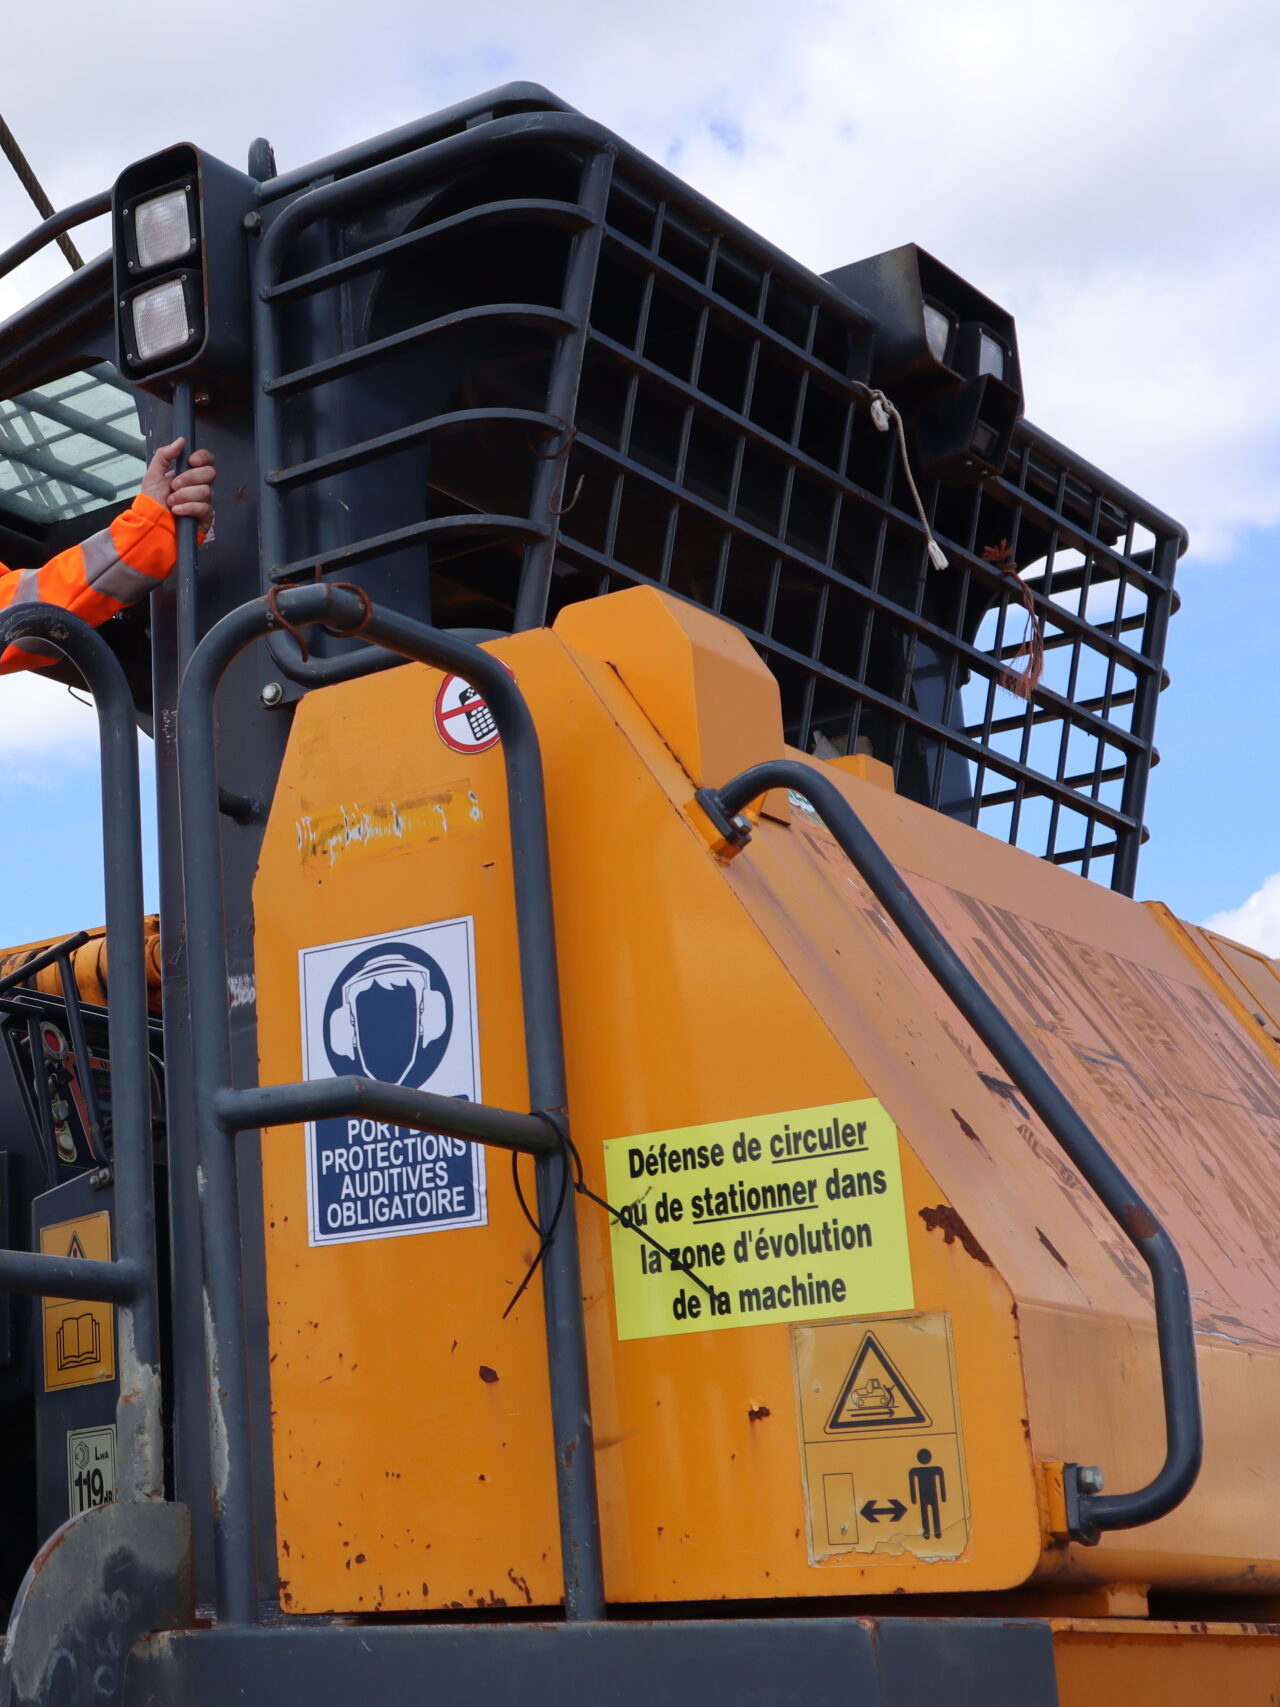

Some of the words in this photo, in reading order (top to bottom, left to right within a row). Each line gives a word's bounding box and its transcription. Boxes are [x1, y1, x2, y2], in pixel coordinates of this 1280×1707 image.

[321, 1136, 467, 1175] PROTECTIONS
[628, 1143, 725, 1179] Défense
[732, 1132, 762, 1164] de
[770, 1118, 867, 1158] circuler
[341, 1160, 448, 1199] AUDITIVES
[620, 1202, 647, 1229] ou
[655, 1193, 683, 1224] de
[692, 1177, 818, 1219] stationner
[826, 1168, 888, 1201] dans
[327, 1186, 466, 1228] OBLIGATOIRE
[640, 1244, 662, 1275] la
[670, 1240, 726, 1271] zone
[734, 1218, 873, 1263] d'évolution
[672, 1288, 701, 1321] de
[708, 1285, 732, 1317] la
[739, 1272, 847, 1313] machine
[75, 1468, 104, 1512] 119
